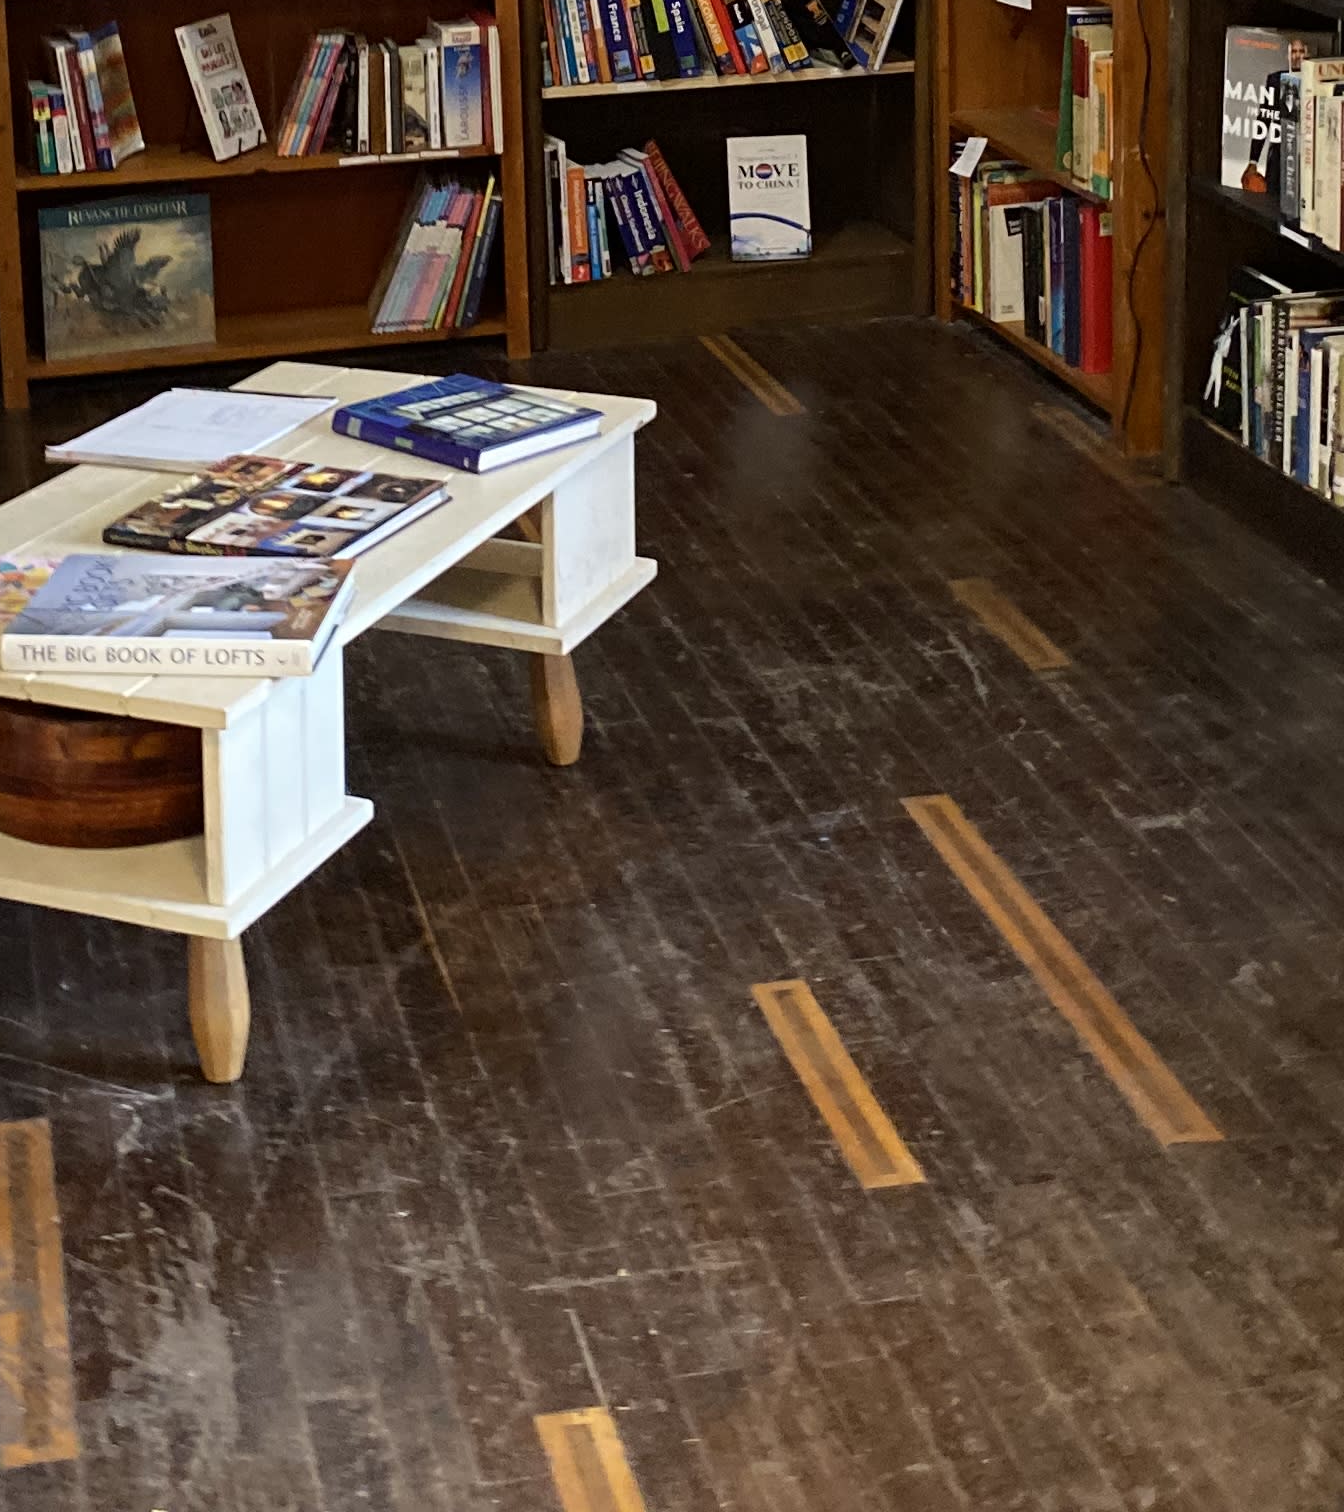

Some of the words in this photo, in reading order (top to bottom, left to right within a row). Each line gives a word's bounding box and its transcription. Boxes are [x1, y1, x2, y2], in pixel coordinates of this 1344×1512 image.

[607, 2, 623, 42] France
[670, 1, 686, 34] Spain
[1223, 79, 1276, 107] MAN
[459, 85, 472, 141] LAROUSSE
[1221, 114, 1283, 144] MIDD
[1260, 107, 1281, 121] THE
[737, 162, 801, 180] MOVE
[737, 180, 754, 191] TO
[1285, 154, 1296, 198] Chief
[633, 189, 657, 241] Indonesia
[670, 195, 708, 250] WALKS
[1275, 308, 1287, 381] AMERICAN
[1274, 384, 1285, 443] SOLDIER
[18, 643, 57, 663] THE
[64, 645, 97, 664] BIG
[105, 646, 161, 665] BOOK
[170, 648, 198, 666] OF
[204, 648, 266, 667] LOFTS
